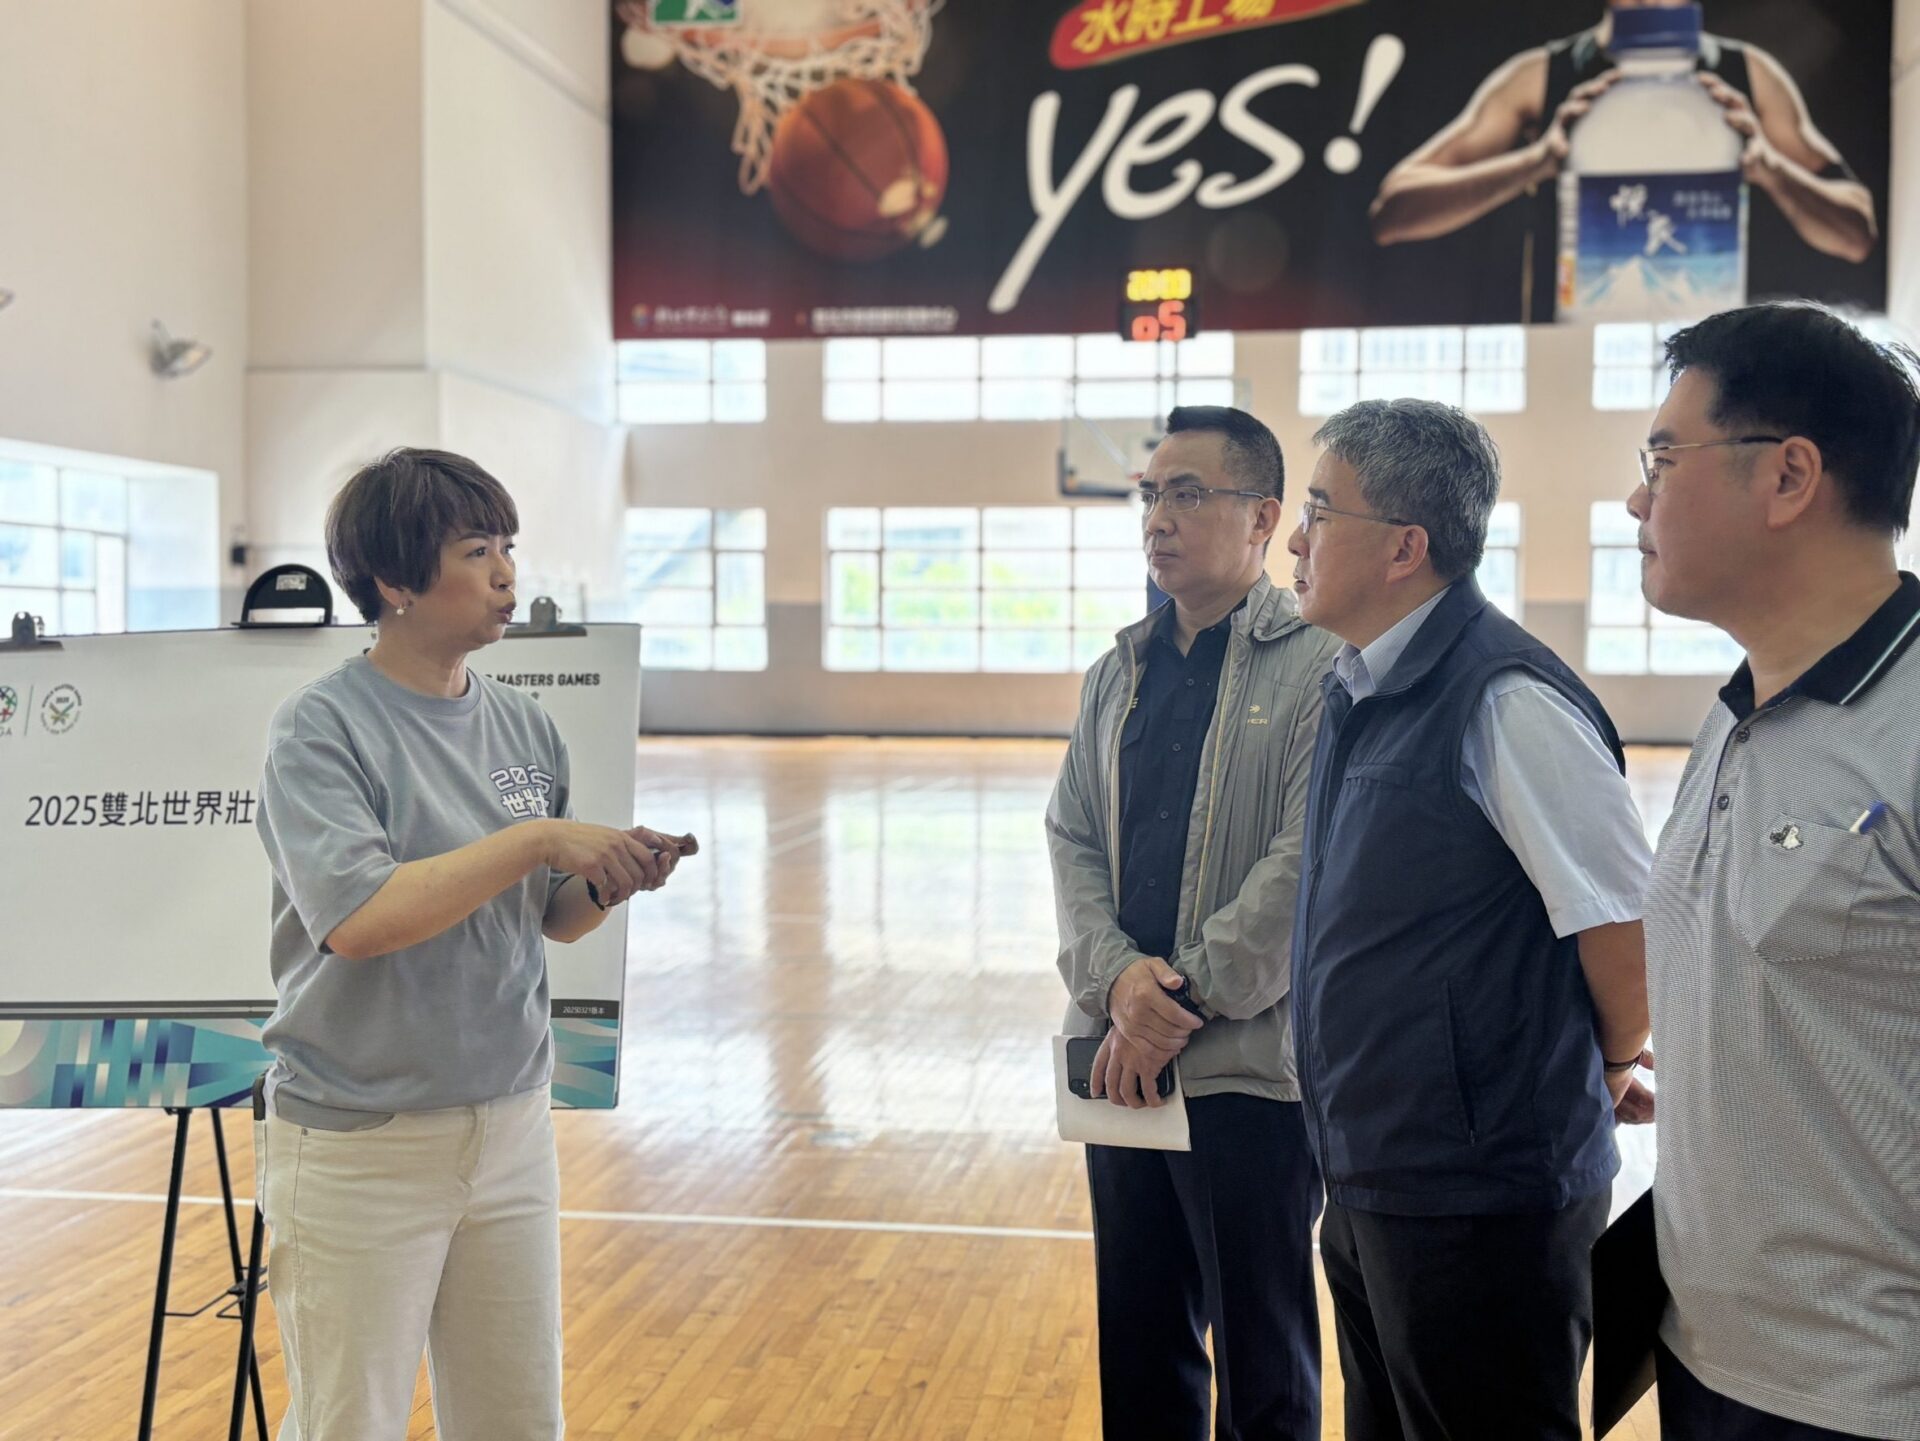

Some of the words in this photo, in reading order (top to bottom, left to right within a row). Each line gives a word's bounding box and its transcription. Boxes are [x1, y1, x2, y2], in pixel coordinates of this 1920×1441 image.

[496, 673, 554, 686] MASTERS
[557, 673, 600, 686] GAMES
[25, 790, 256, 827] 2025雙北世界壯
